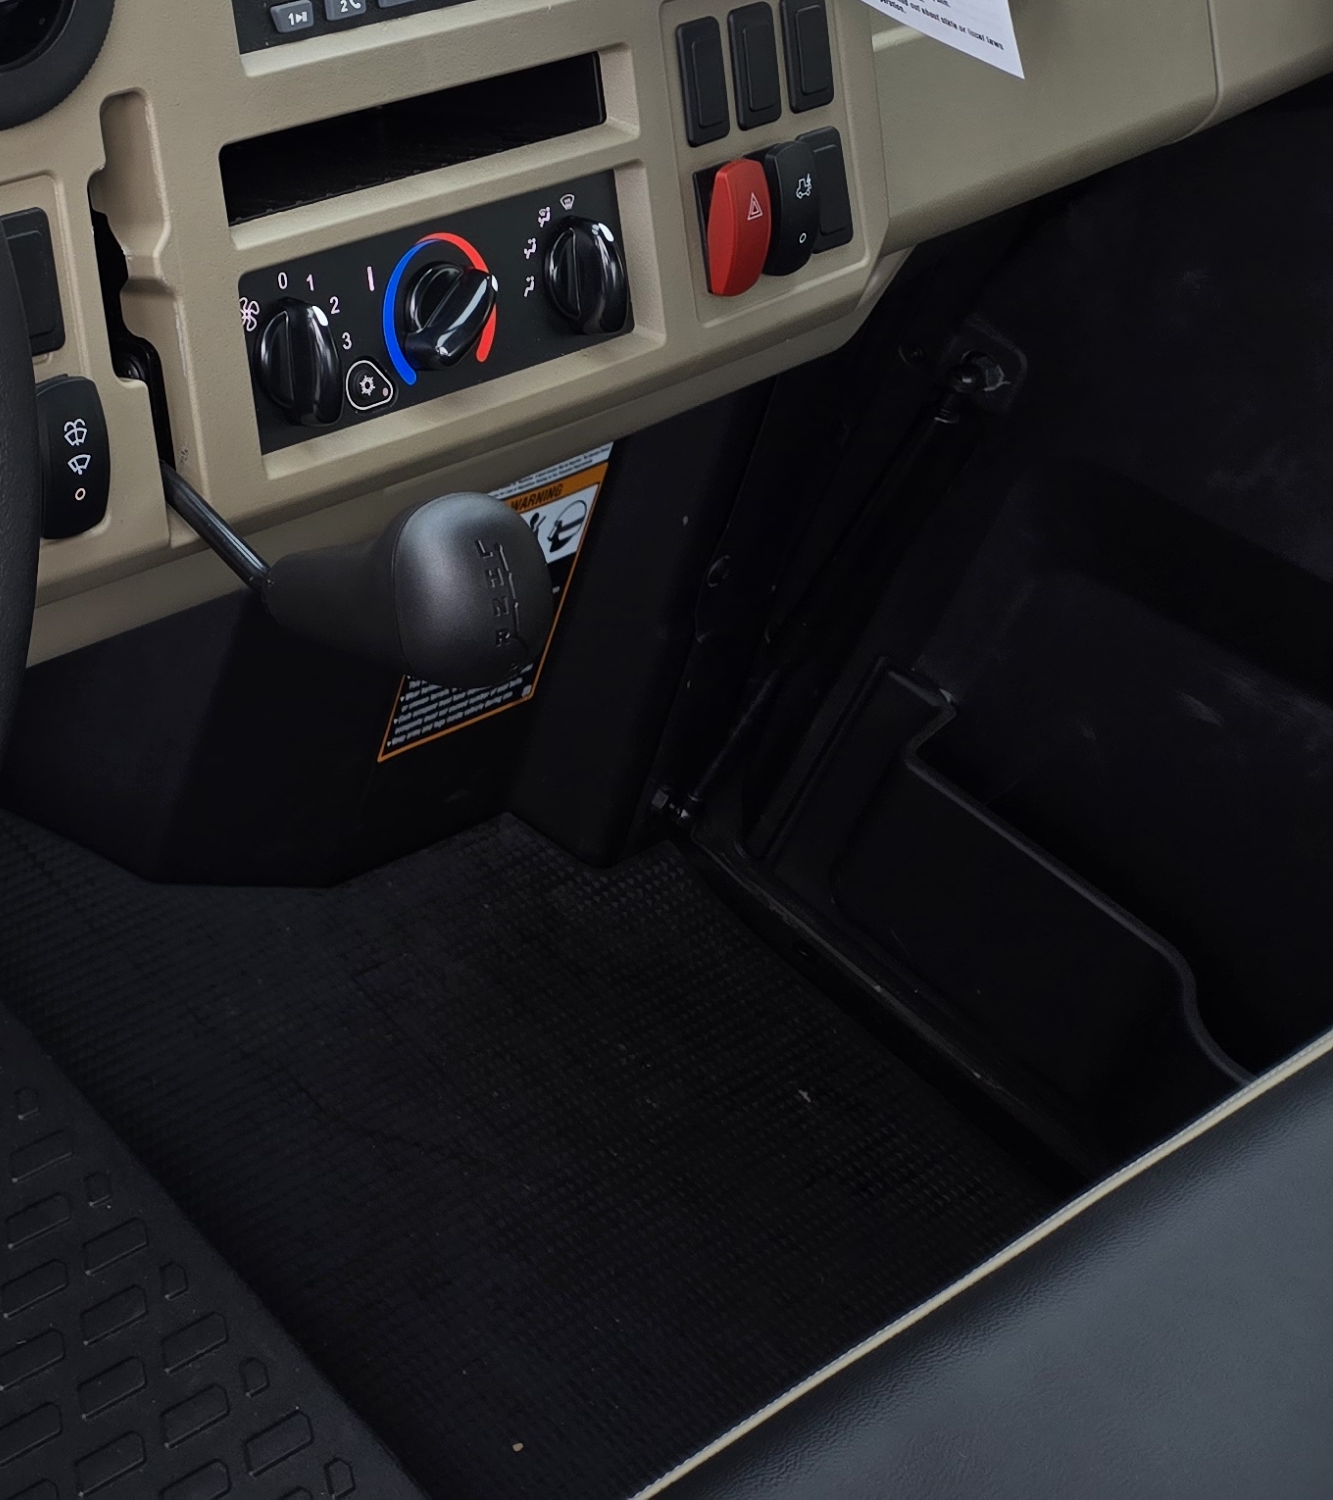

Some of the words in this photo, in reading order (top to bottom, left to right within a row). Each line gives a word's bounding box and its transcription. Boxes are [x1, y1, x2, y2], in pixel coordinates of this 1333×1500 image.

[340, 0, 348, 13] 2
[306, 274, 315, 291] 1
[329, 296, 340, 314] 2
[342, 332, 352, 350] 3
[510, 483, 564, 511] WARNING
